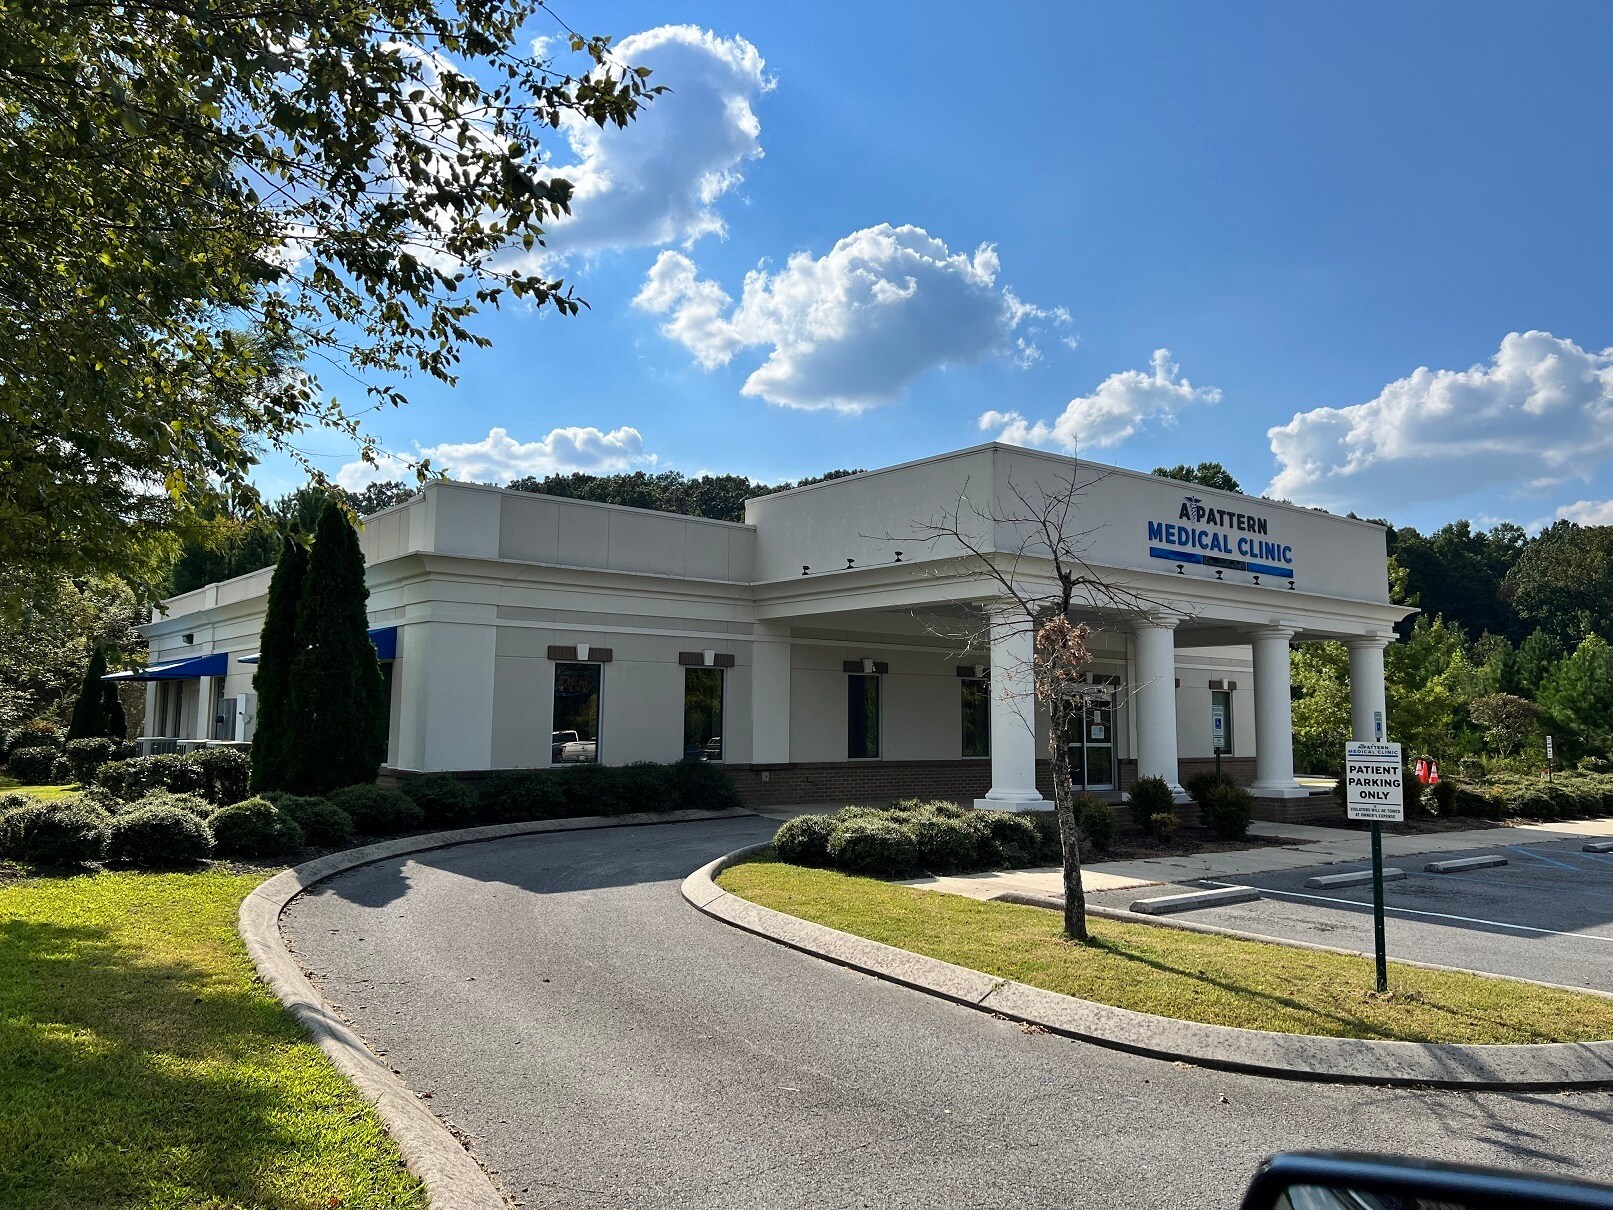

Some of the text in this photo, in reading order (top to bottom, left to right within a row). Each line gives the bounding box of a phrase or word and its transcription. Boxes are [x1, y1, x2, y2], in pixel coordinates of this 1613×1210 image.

[1148, 521, 1293, 563] MEDICAL CLINIC
[1350, 766, 1398, 775] PATIENT
[1348, 778, 1400, 788] PARKING
[1360, 791, 1390, 800] ONLY
